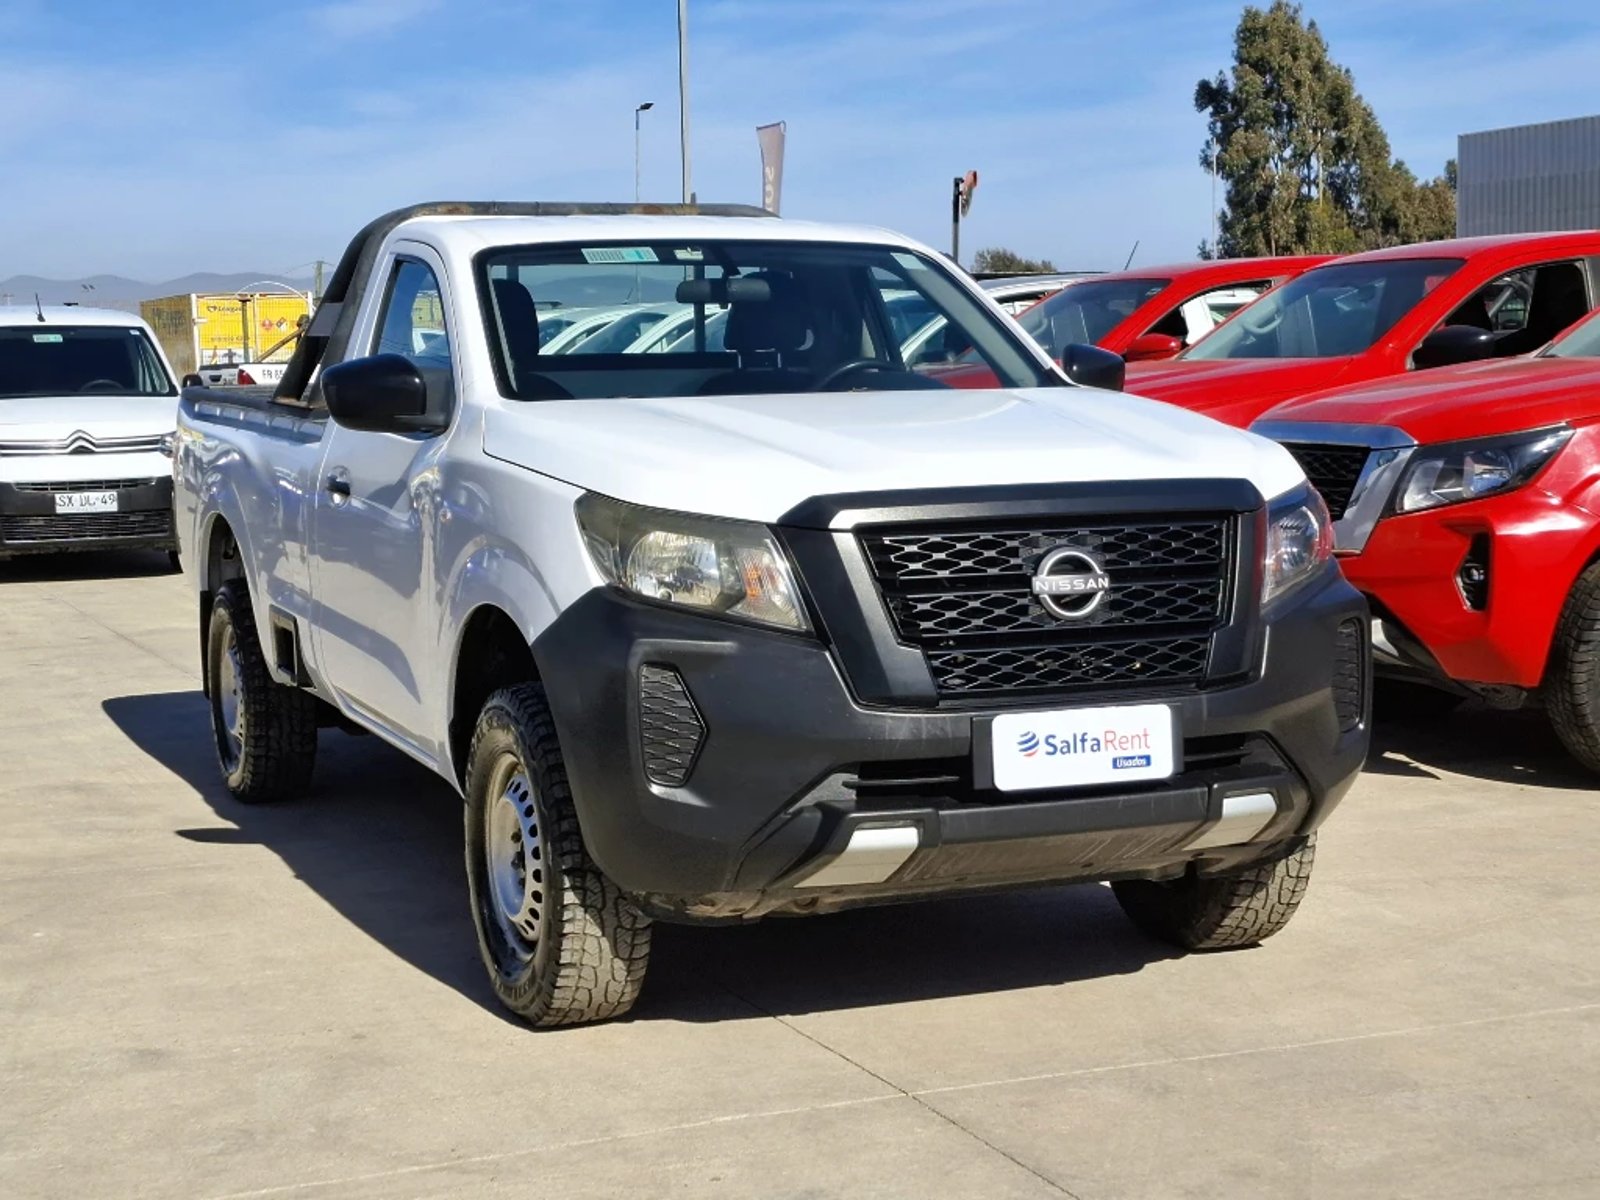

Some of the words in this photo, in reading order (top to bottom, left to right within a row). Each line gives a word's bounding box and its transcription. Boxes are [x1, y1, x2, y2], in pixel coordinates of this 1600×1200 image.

[58, 495, 75, 507] SX
[1035, 577, 1109, 592] NISSAN
[1116, 756, 1146, 768] Usados
